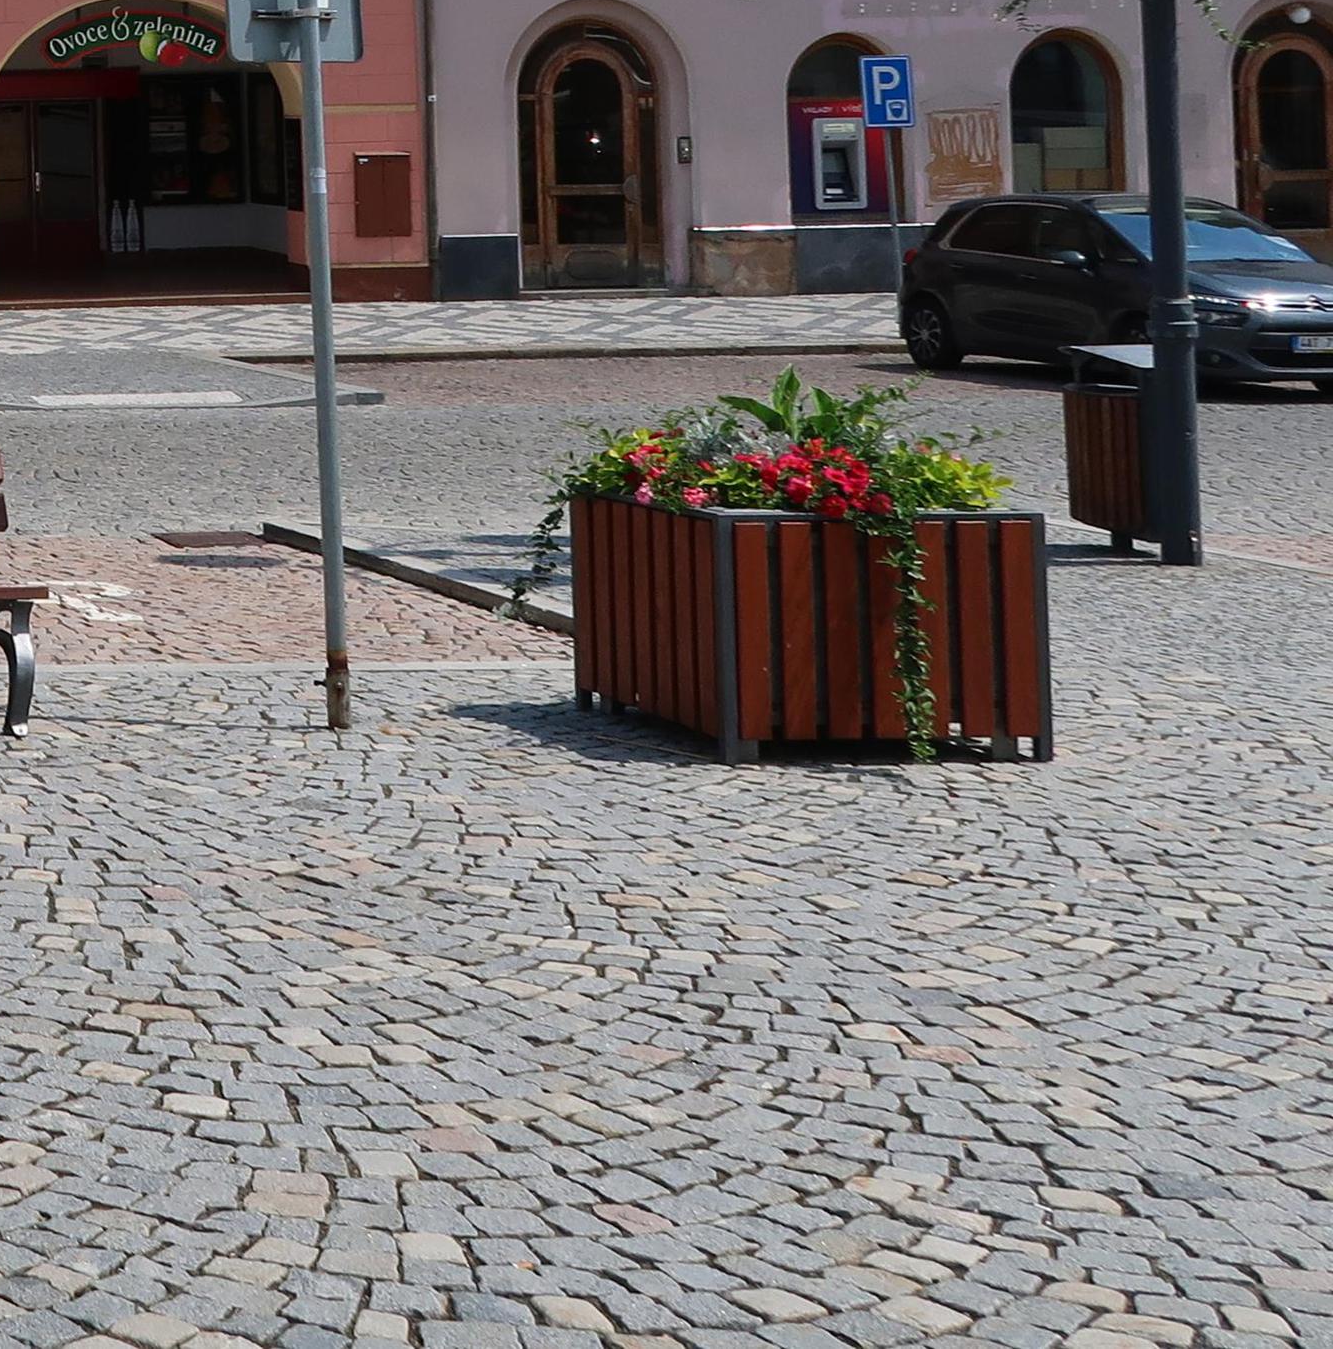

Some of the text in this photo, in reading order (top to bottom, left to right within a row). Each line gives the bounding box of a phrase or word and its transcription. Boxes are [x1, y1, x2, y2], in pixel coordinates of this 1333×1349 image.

[49, 6, 217, 57] Ovoce & zelenina
[872, 66, 900, 105] P
